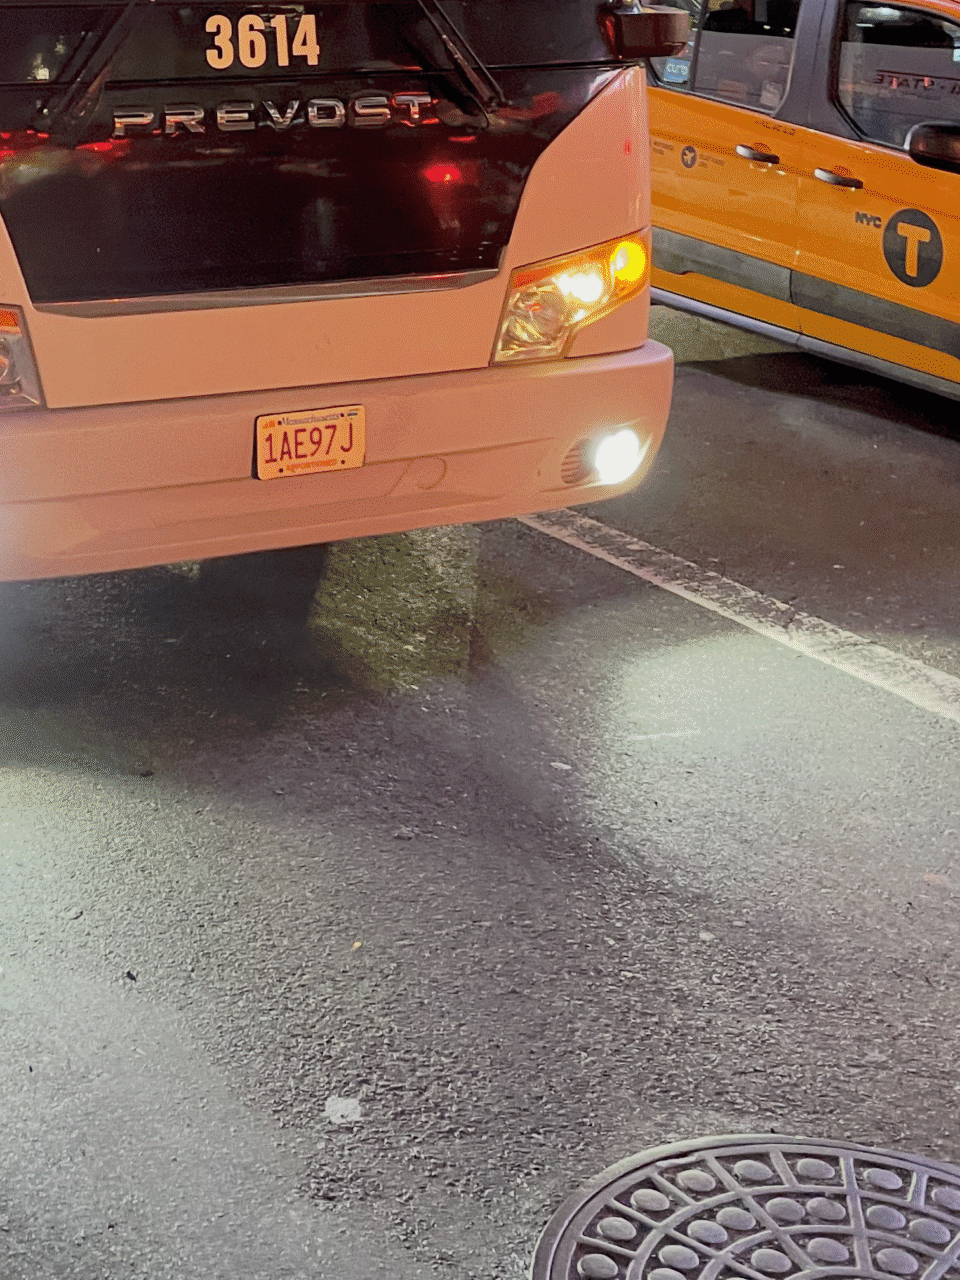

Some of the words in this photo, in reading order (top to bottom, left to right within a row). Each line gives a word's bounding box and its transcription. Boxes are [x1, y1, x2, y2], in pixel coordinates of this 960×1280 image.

[204, 13, 321, 70] 3614
[112, 93, 433, 137] PREVOST
[854, 210, 882, 229] NYC
[896, 221, 932, 278] T
[264, 422, 353, 465] 1AE97J
